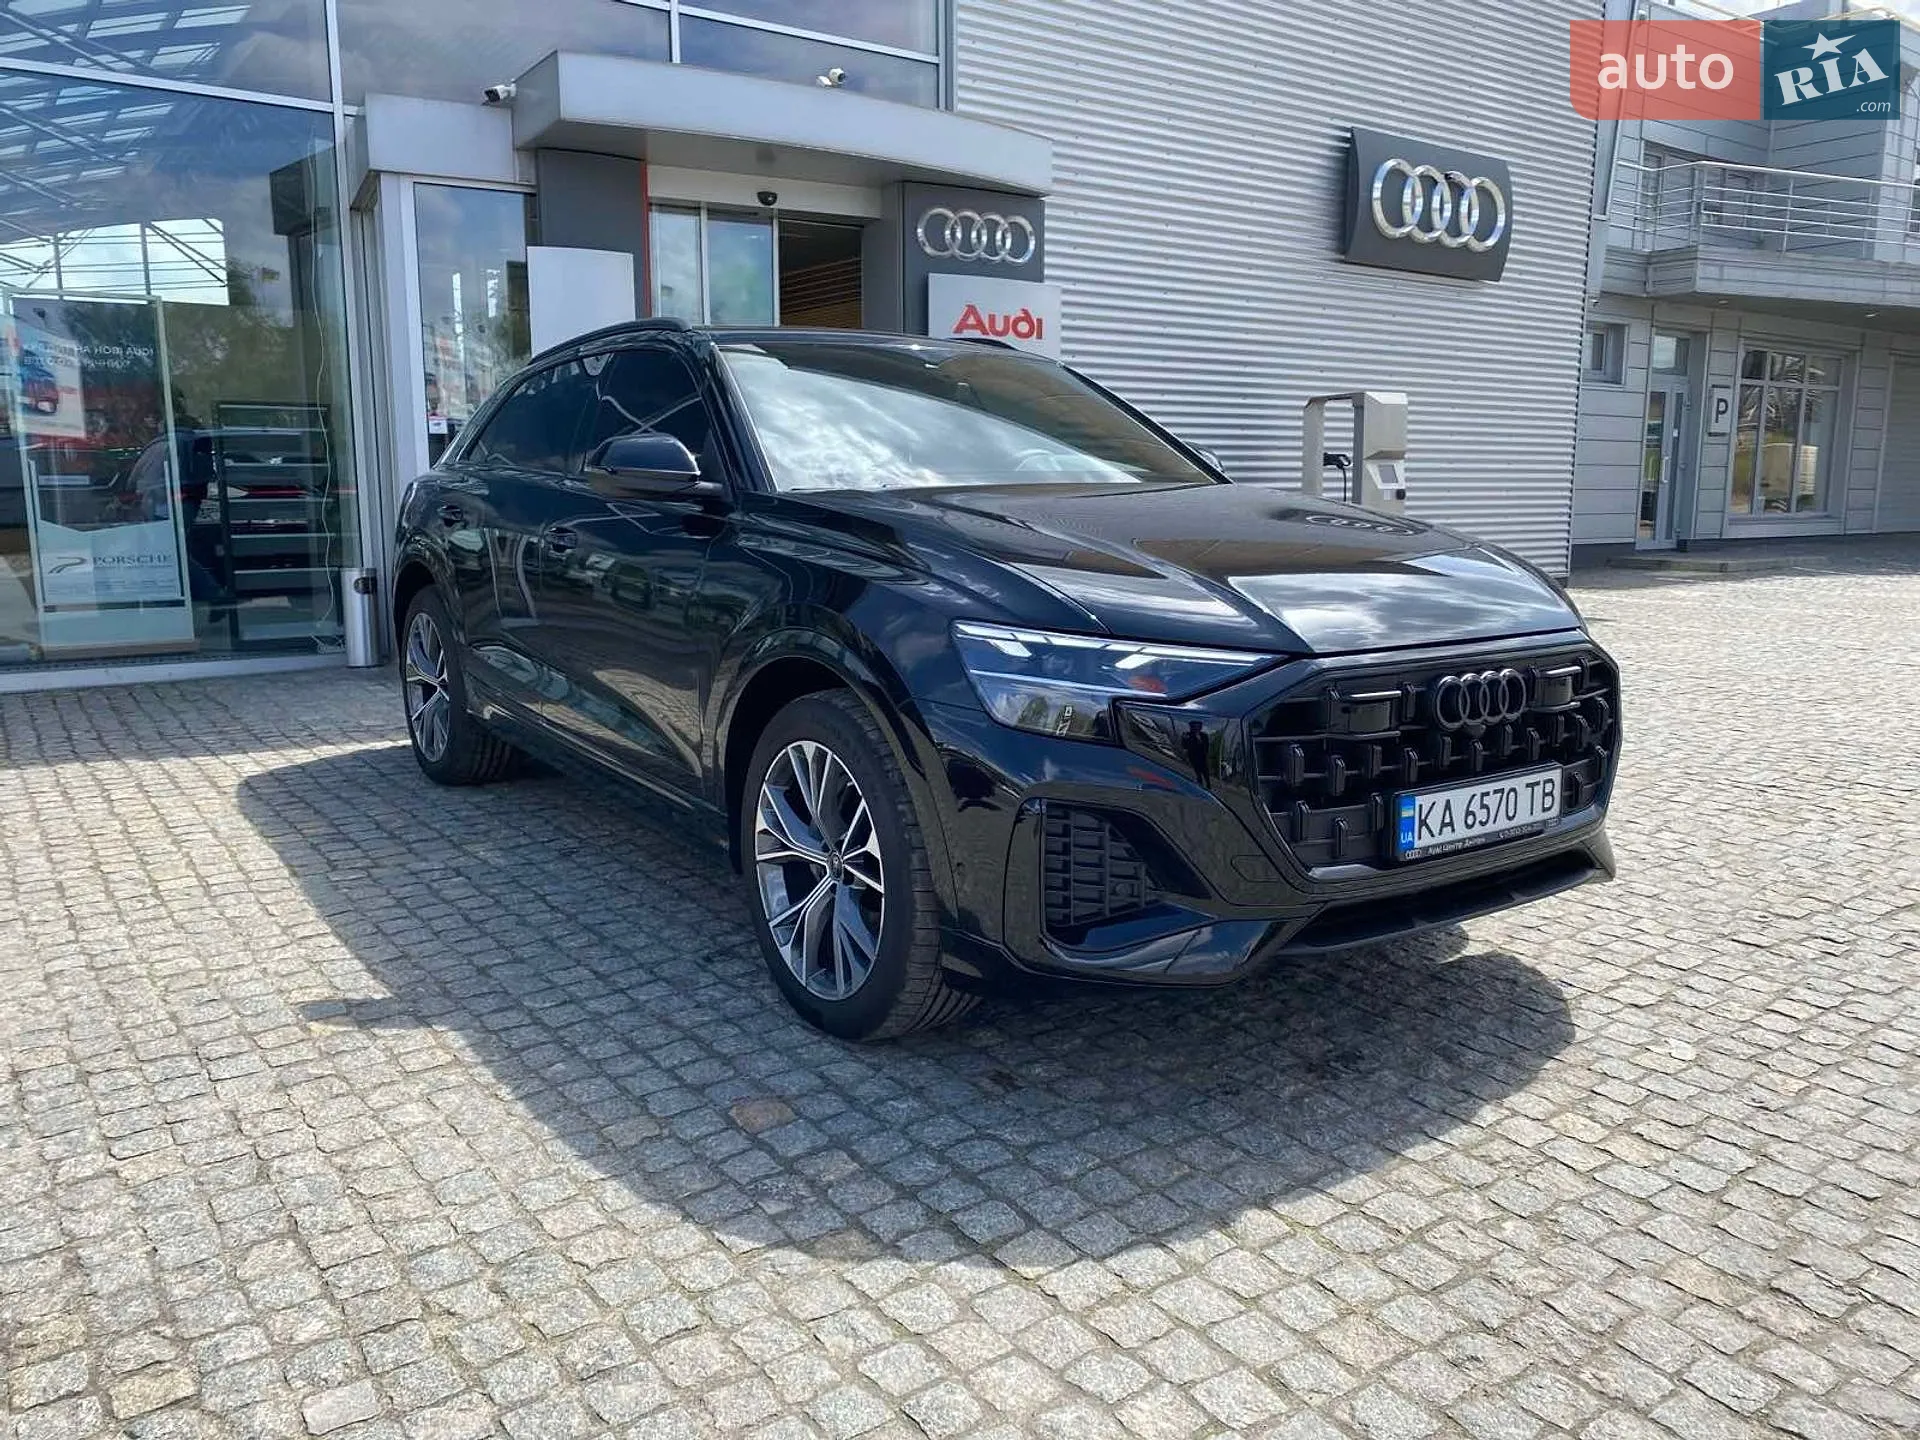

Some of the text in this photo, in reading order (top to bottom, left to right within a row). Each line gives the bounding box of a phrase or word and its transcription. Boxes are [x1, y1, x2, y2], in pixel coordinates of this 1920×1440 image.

[952, 303, 1043, 340] Audi
[1715, 398, 1729, 423] P
[1418, 778, 1556, 840] KA 6570 TB
[1400, 832, 1414, 844] UA
